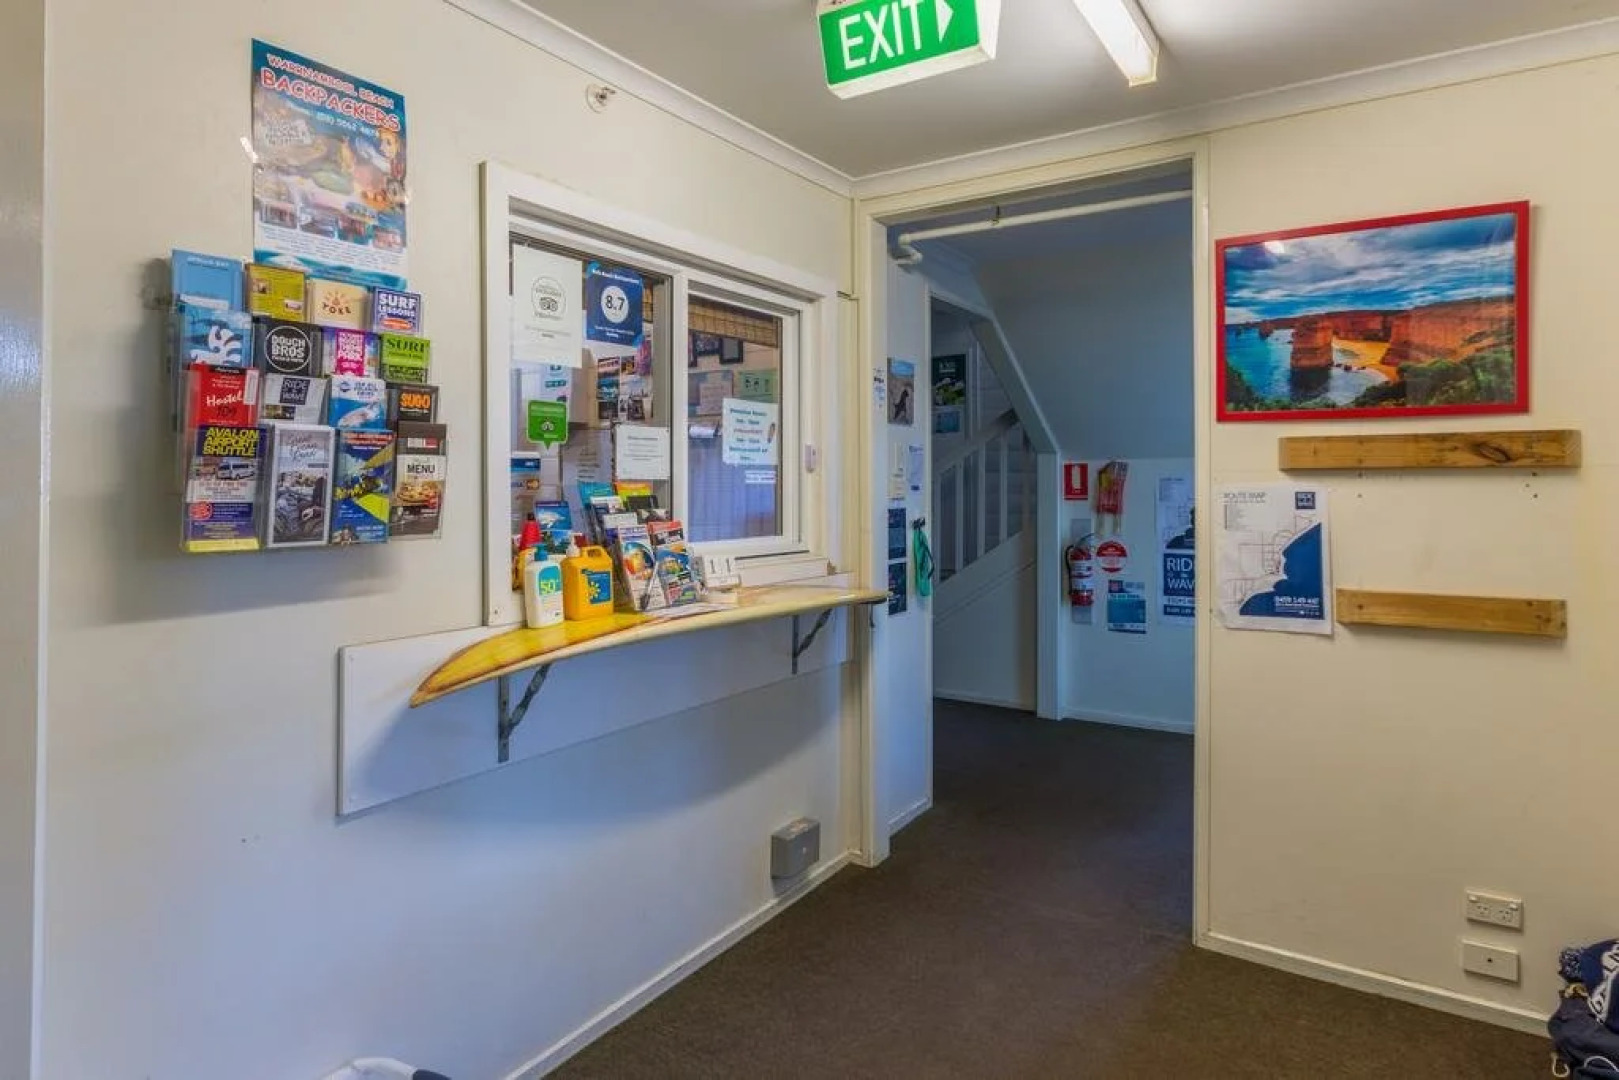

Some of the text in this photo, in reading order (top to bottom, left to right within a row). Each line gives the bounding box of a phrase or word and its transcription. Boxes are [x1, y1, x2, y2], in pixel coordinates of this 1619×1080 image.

[839, 0, 924, 70] EXIT
[260, 66, 401, 132] BACKPACKERS
[379, 293, 417, 309] SURF
[605, 295, 625, 311] 8.7
[271, 344, 306, 358] BROS
[206, 390, 244, 407] Hostel
[205, 426, 259, 442] AVALON
[204, 436, 259, 449] AIRPORT
[202, 445, 256, 456] SHUTTLE
[407, 464, 436, 474] MENU
[1166, 557, 1193, 572] RID
[1167, 578, 1195, 590] WAV
